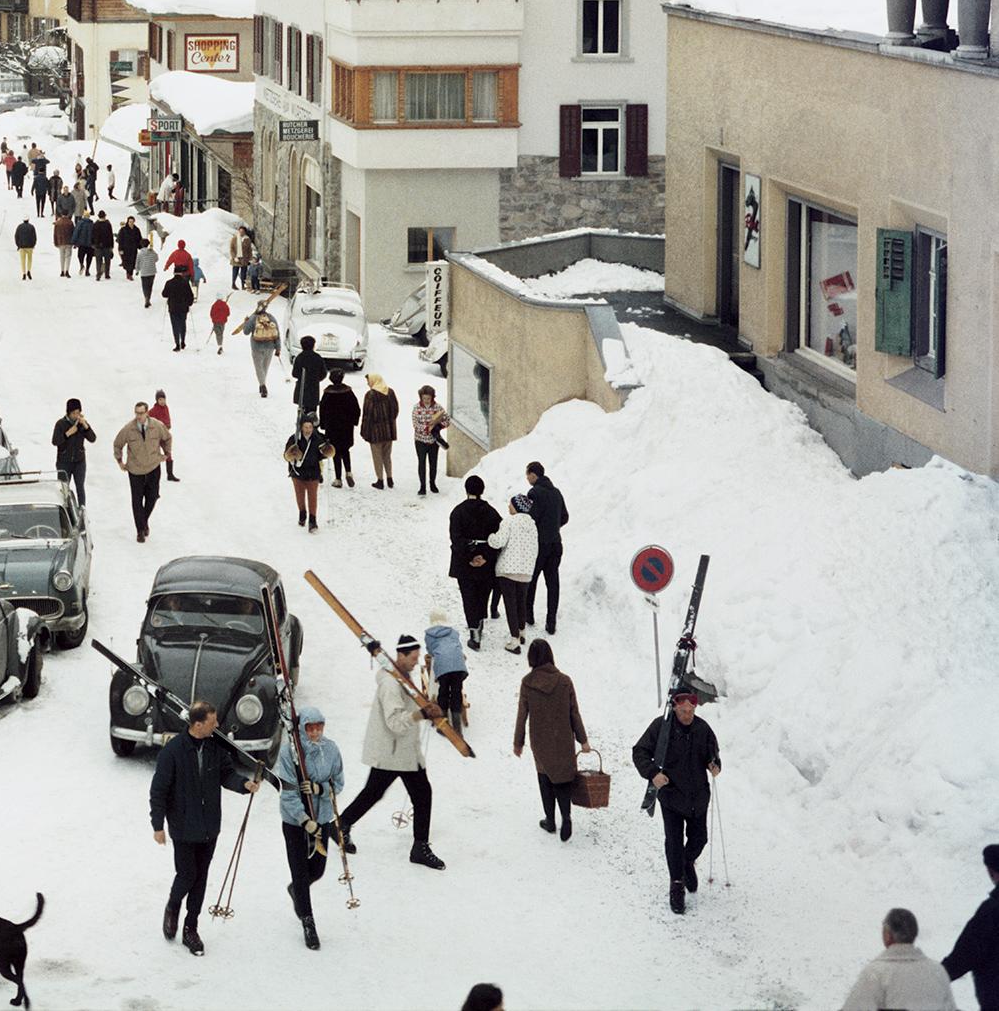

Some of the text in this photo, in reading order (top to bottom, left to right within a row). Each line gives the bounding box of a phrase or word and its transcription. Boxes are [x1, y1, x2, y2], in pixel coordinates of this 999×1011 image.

[188, 40, 236, 51] SHOPPING
[191, 51, 232, 65] Center
[150, 119, 180, 132] SPORT
[433, 267, 443, 327] COIFFEUR
